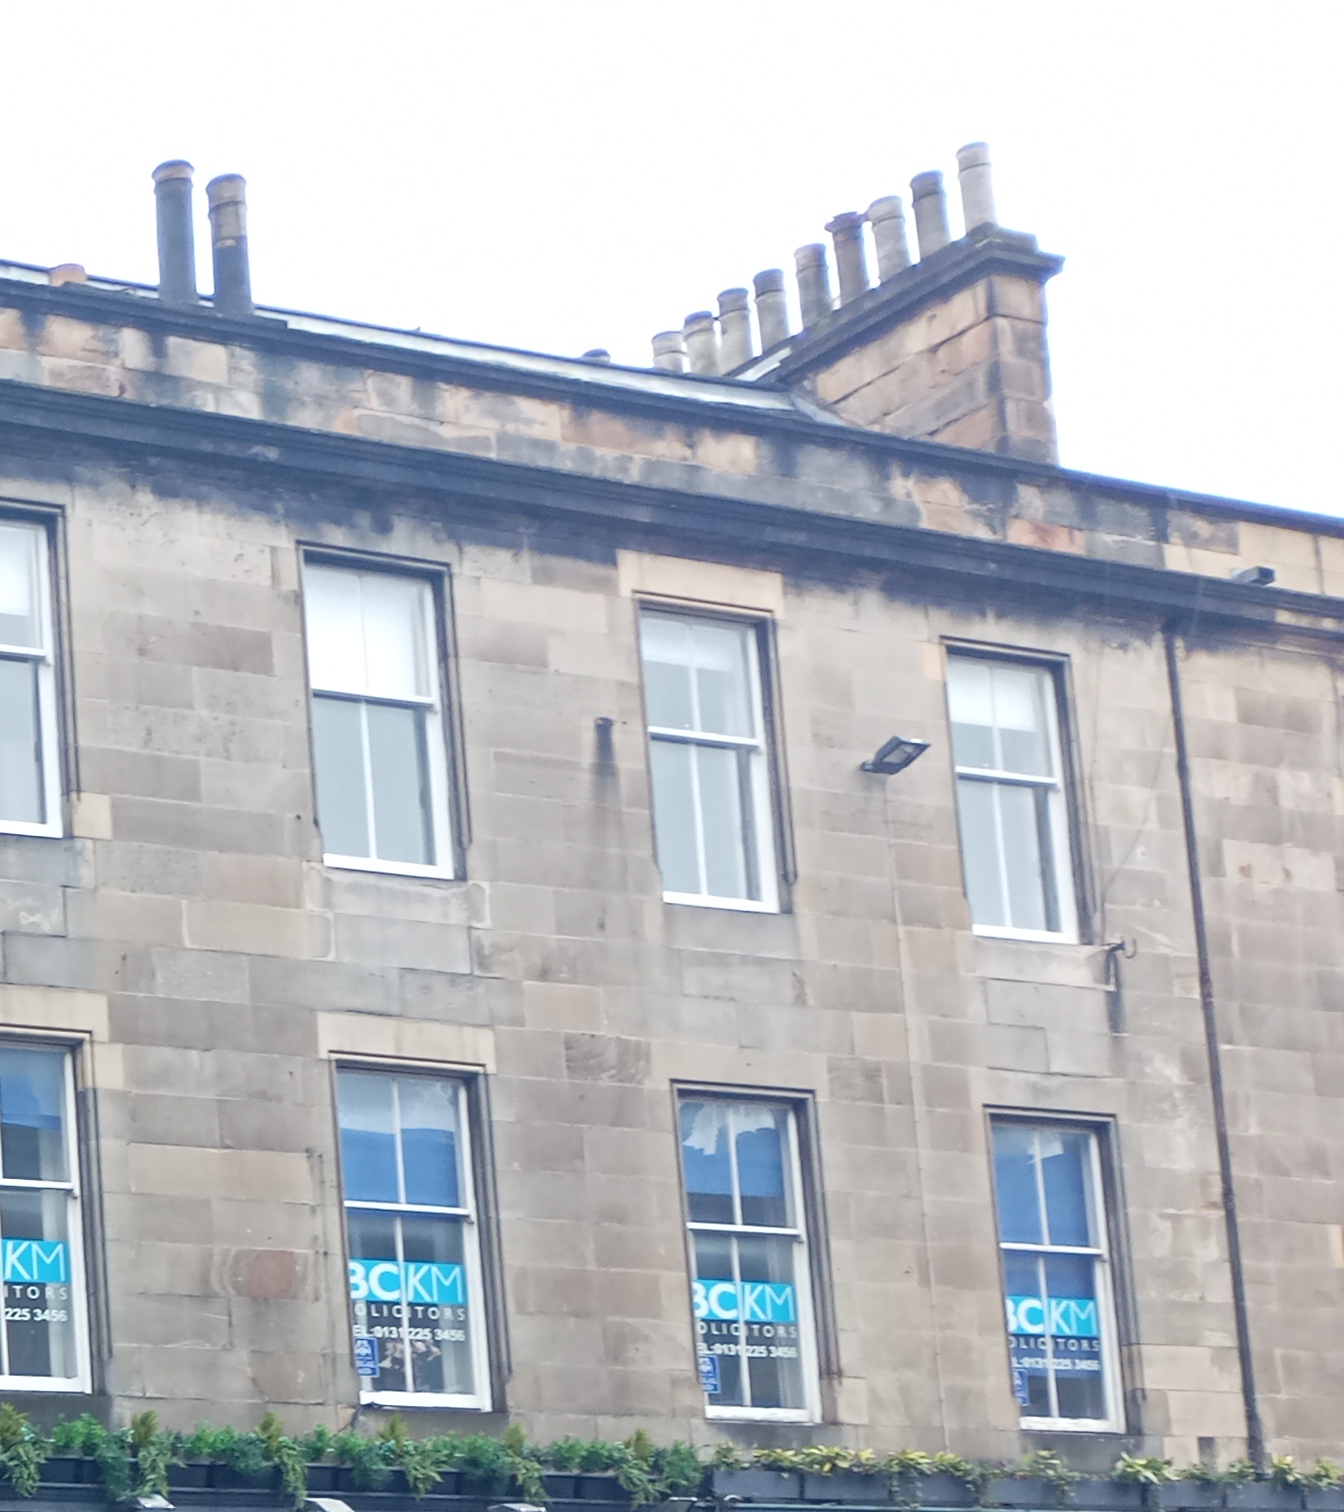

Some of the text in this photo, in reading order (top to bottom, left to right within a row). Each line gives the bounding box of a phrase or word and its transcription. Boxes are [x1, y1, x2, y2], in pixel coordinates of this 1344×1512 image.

[349, 1261, 463, 1302] BCKM
[4, 1307, 31, 1321] 225
[33, 1308, 68, 1322] 3456
